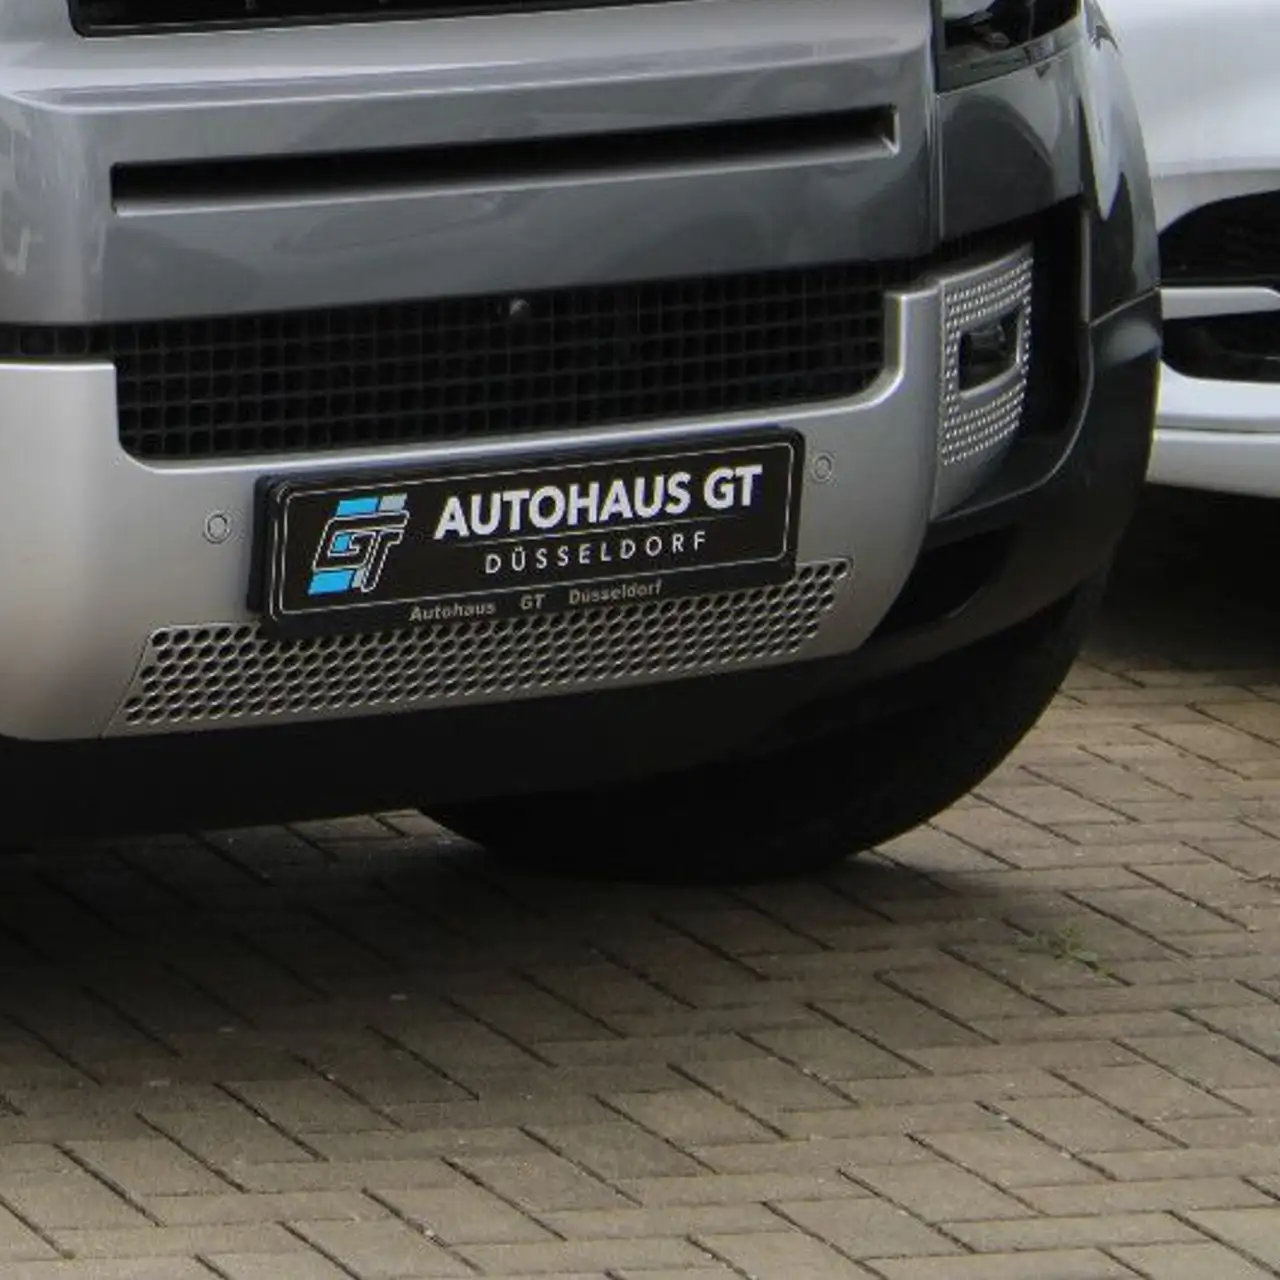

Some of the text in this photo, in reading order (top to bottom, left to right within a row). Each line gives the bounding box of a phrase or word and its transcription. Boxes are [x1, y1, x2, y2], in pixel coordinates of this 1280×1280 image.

[433, 464, 763, 540] AUTOHAUS GT
[484, 530, 707, 575] DÜSSELDORF
[408, 601, 496, 622] Autohaus
[520, 593, 545, 610] GT
